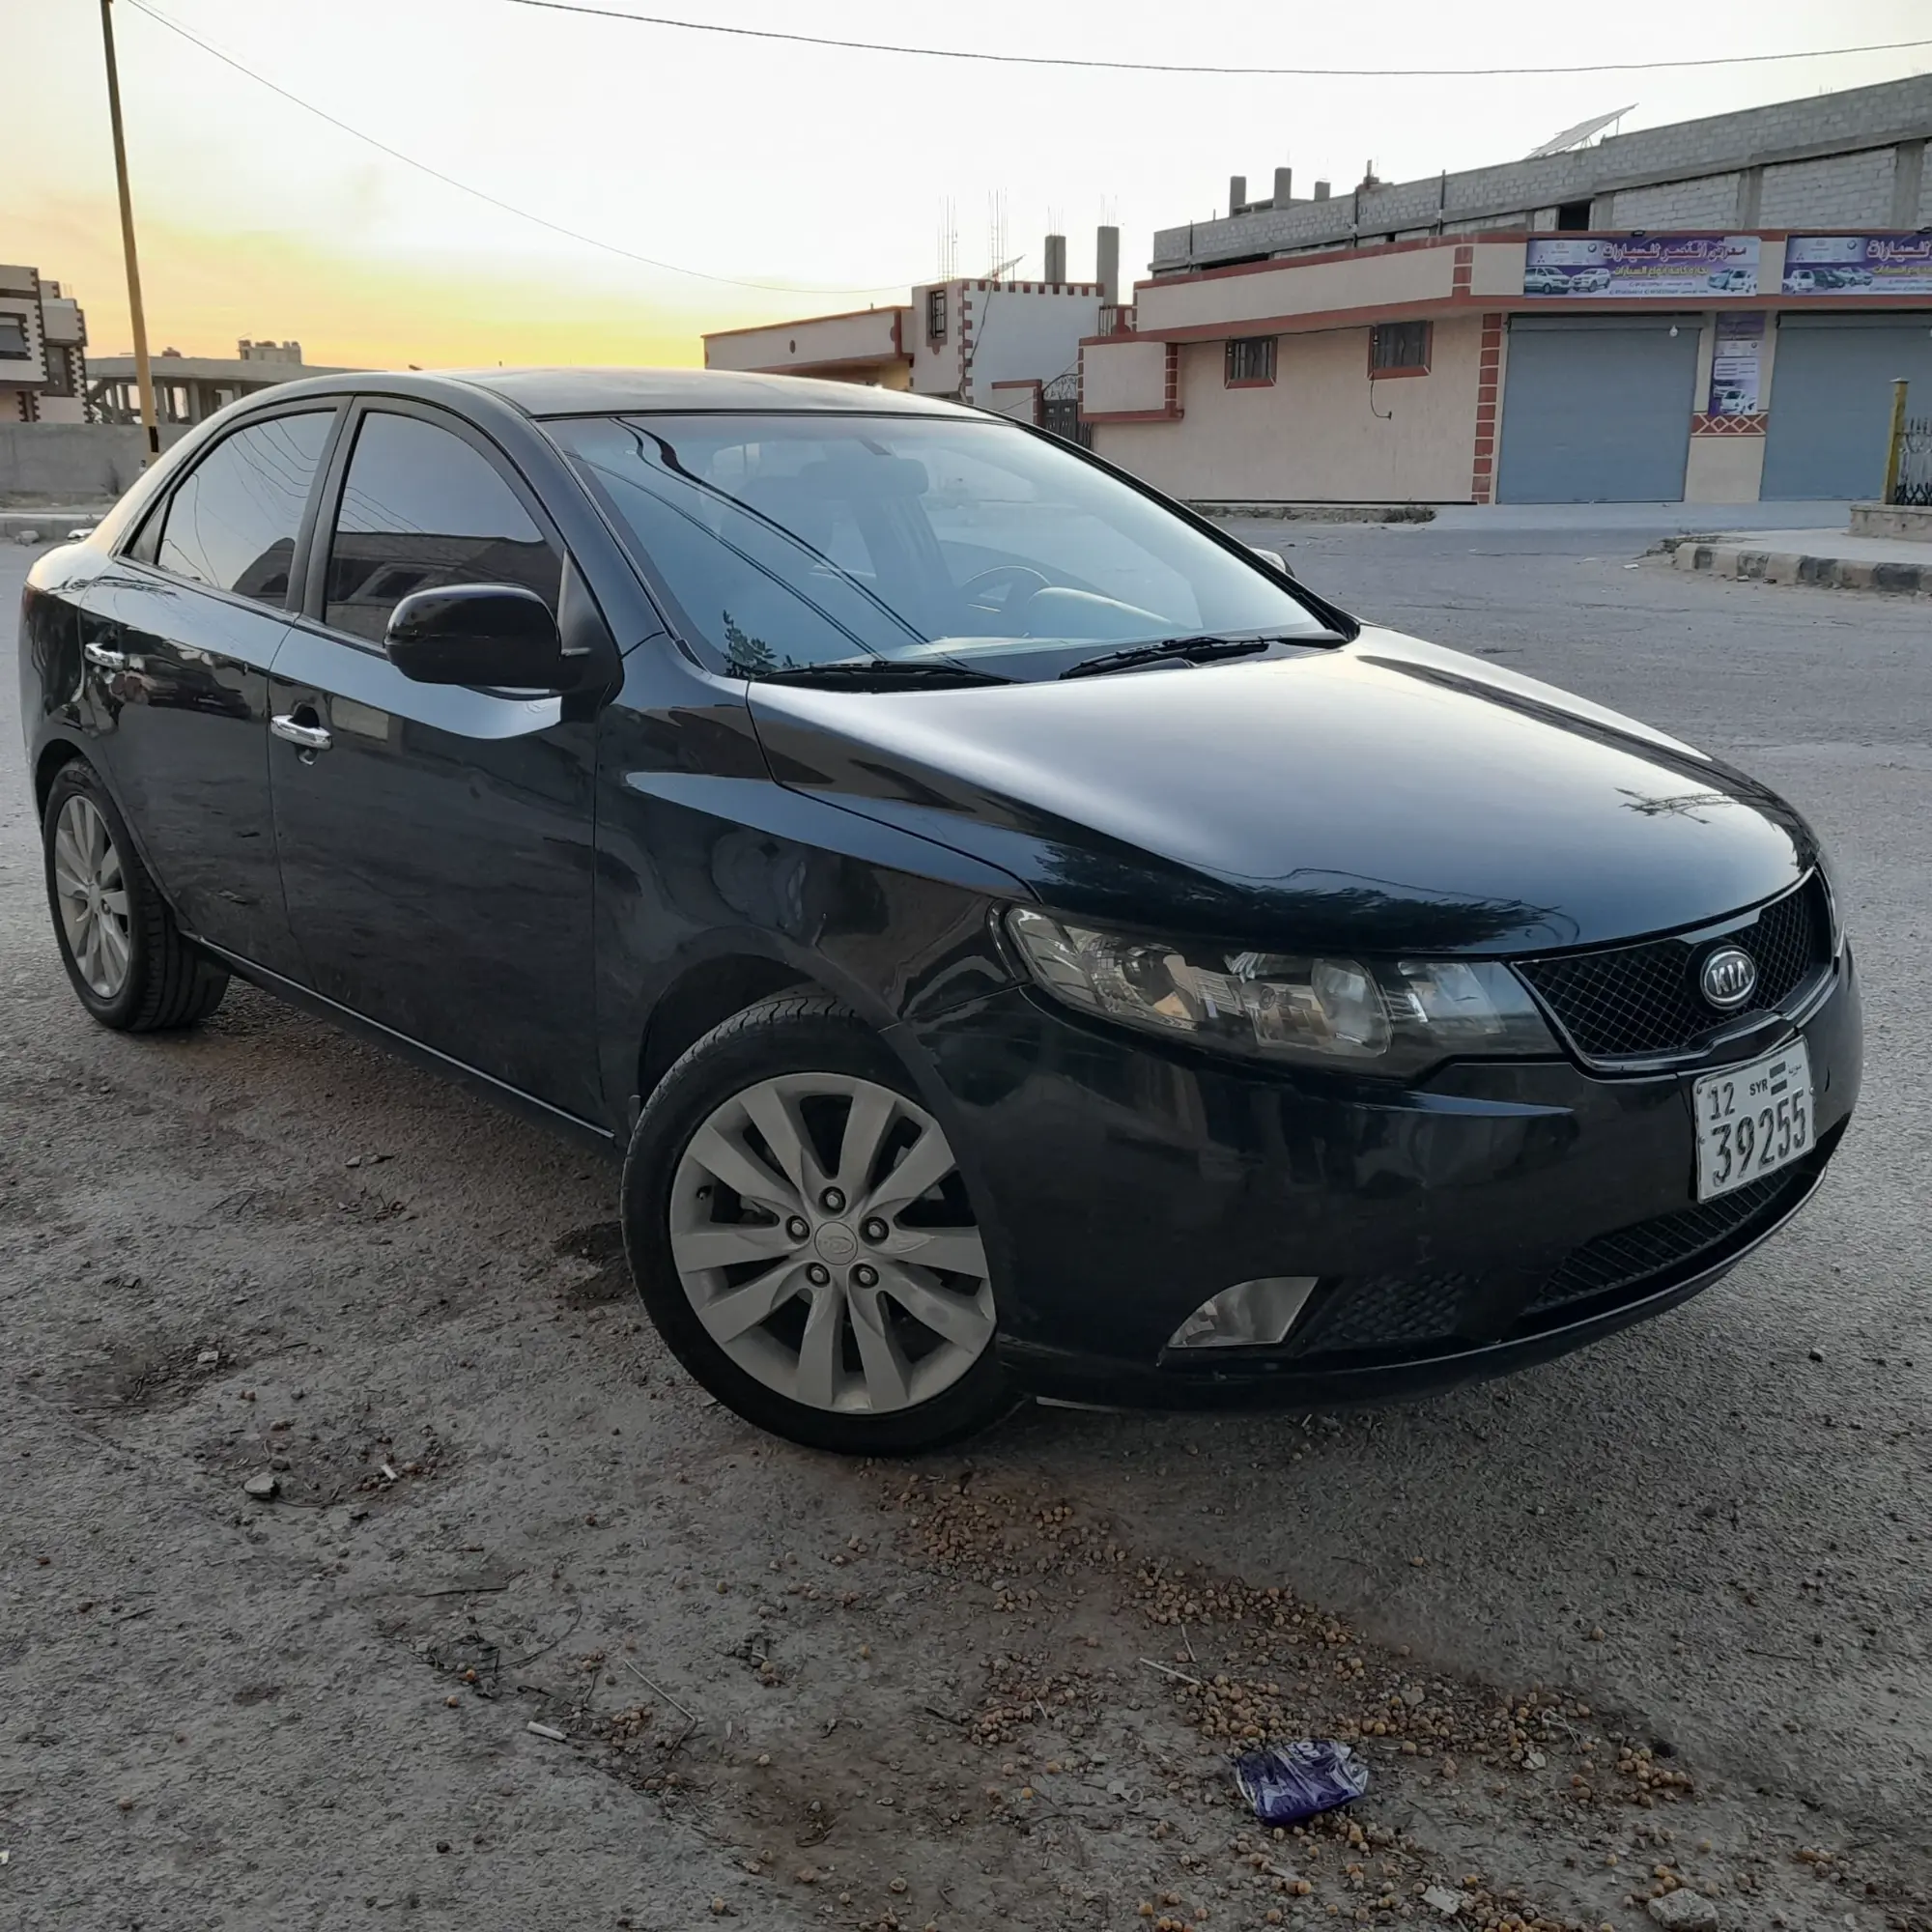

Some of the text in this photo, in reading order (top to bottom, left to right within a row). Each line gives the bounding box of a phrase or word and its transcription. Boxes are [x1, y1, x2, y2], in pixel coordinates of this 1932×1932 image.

[1602, 242, 1661, 263] للسيارات
[1711, 960, 1750, 995] KIA
[1707, 1081, 1735, 1121] 12
[1749, 1079, 1768, 1096] SYR
[1711, 1088, 1806, 1187] 39255
